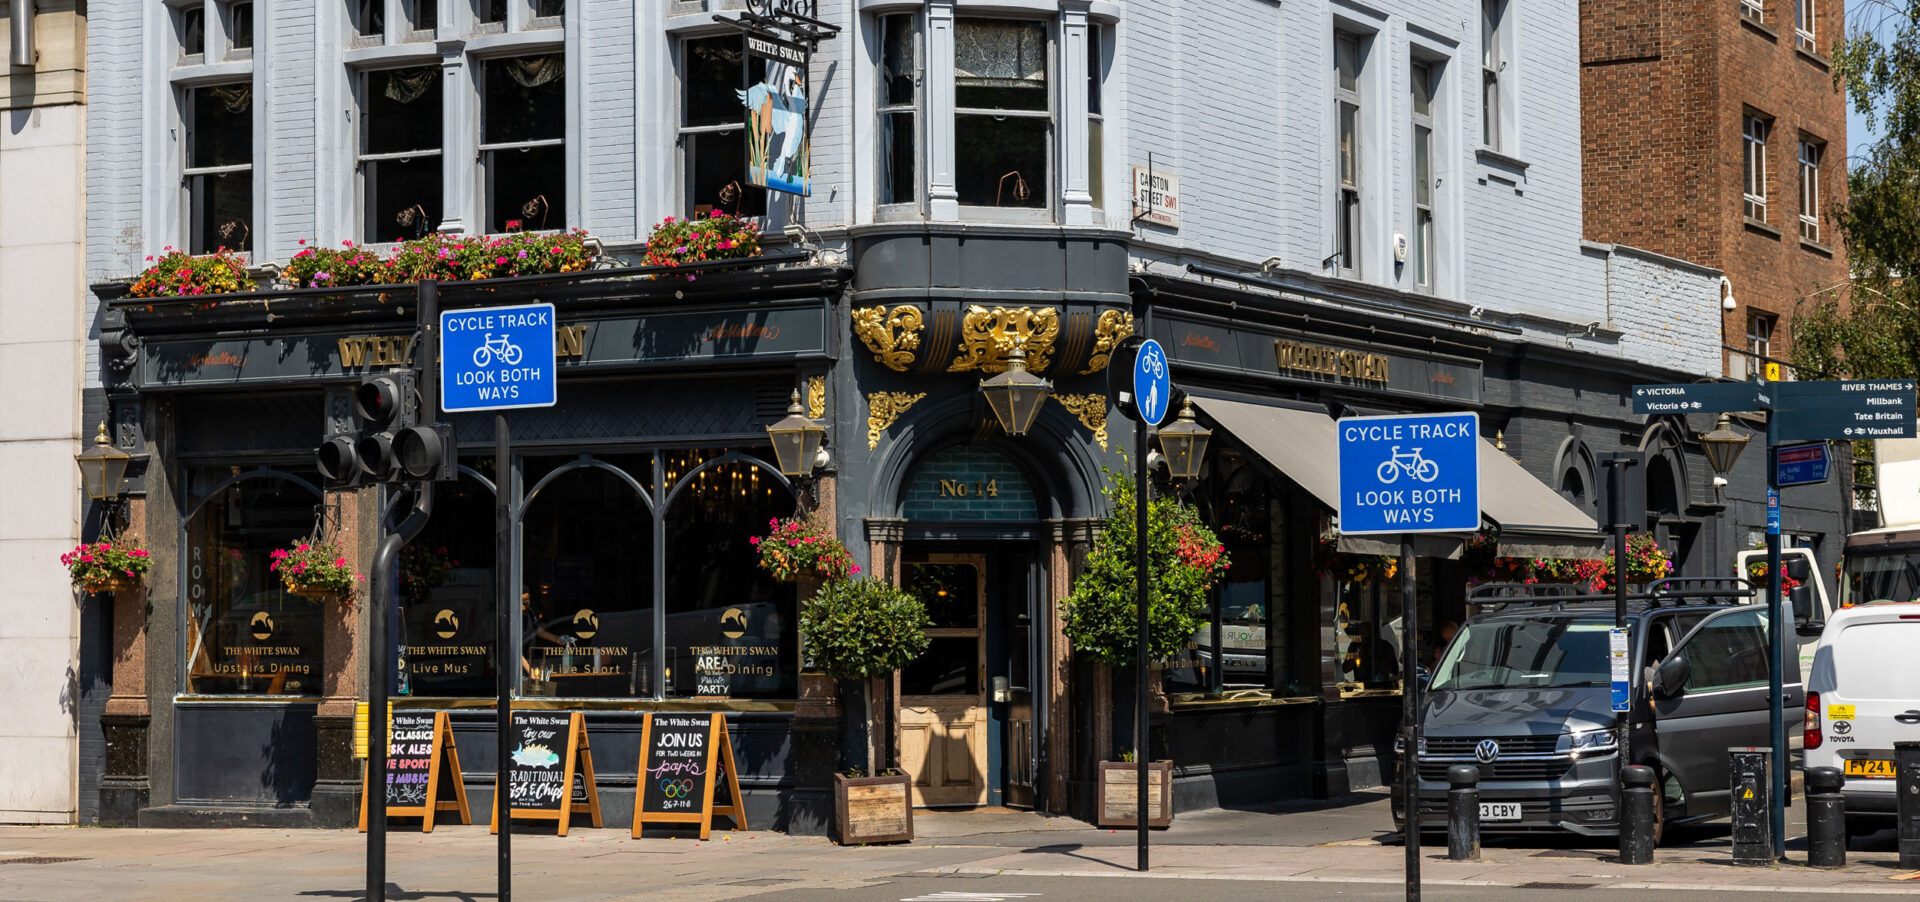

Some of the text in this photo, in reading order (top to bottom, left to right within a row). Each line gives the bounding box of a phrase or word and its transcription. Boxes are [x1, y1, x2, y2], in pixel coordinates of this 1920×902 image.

[748, 36, 805, 63] WHITE SWAN
[1140, 172, 1169, 192] CASTON
[1140, 188, 1177, 210] STEET SW1
[448, 312, 548, 332] CYCLE TRACK
[338, 335, 420, 366] WHI
[1275, 339, 1337, 375] WHITE
[1340, 349, 1389, 382] SWAN
[456, 367, 541, 386] LOOK BOTH
[478, 385, 519, 400] WAYS
[1646, 388, 1685, 396] VICTORIA
[1841, 383, 1903, 392] RIVER THAMES
[1646, 401, 1679, 410] Victoria
[1866, 397, 1903, 405] Millbank
[1854, 411, 1903, 421] Tate Britain
[1345, 422, 1470, 442] CYCLE TRACK
[1867, 427, 1904, 435] Vauxhall
[940, 478, 998, 497] No 14
[1356, 488, 1461, 506] LOOK BOTH
[1383, 507, 1435, 524] WAYS
[224, 647, 300, 655] THE WHITE SWAN
[407, 646, 427, 655] THE
[428, 646, 458, 655] WHITE
[459, 646, 487, 655] SWAN
[545, 647, 628, 656] THE WHITE SWAN
[749, 646, 779, 655] SWAN
[214, 663, 310, 675] Upstairs Dining
[413, 663, 438, 673] Live
[697, 656, 729, 670] AREA
[551, 664, 620, 676] Live Sport
[727, 664, 773, 677] Dining
[697, 684, 730, 694] PARTY
[396, 717, 415, 725] White
[416, 717, 433, 725] Swan
[514, 717, 528, 725] The
[529, 717, 549, 725] White
[655, 718, 710, 727] The White Swan
[394, 731, 434, 741] CLASSICS
[522, 727, 537, 745] try
[657, 733, 703, 748] JOIN US
[408, 744, 433, 755] ALES
[399, 759, 432, 770] SPORT
[647, 759, 706, 779] paris
[1850, 760, 1884, 773] FY24
[396, 773, 429, 784] MUSIC
[510, 770, 564, 782] RADITIONAL
[1492, 805, 1516, 817] CBY
